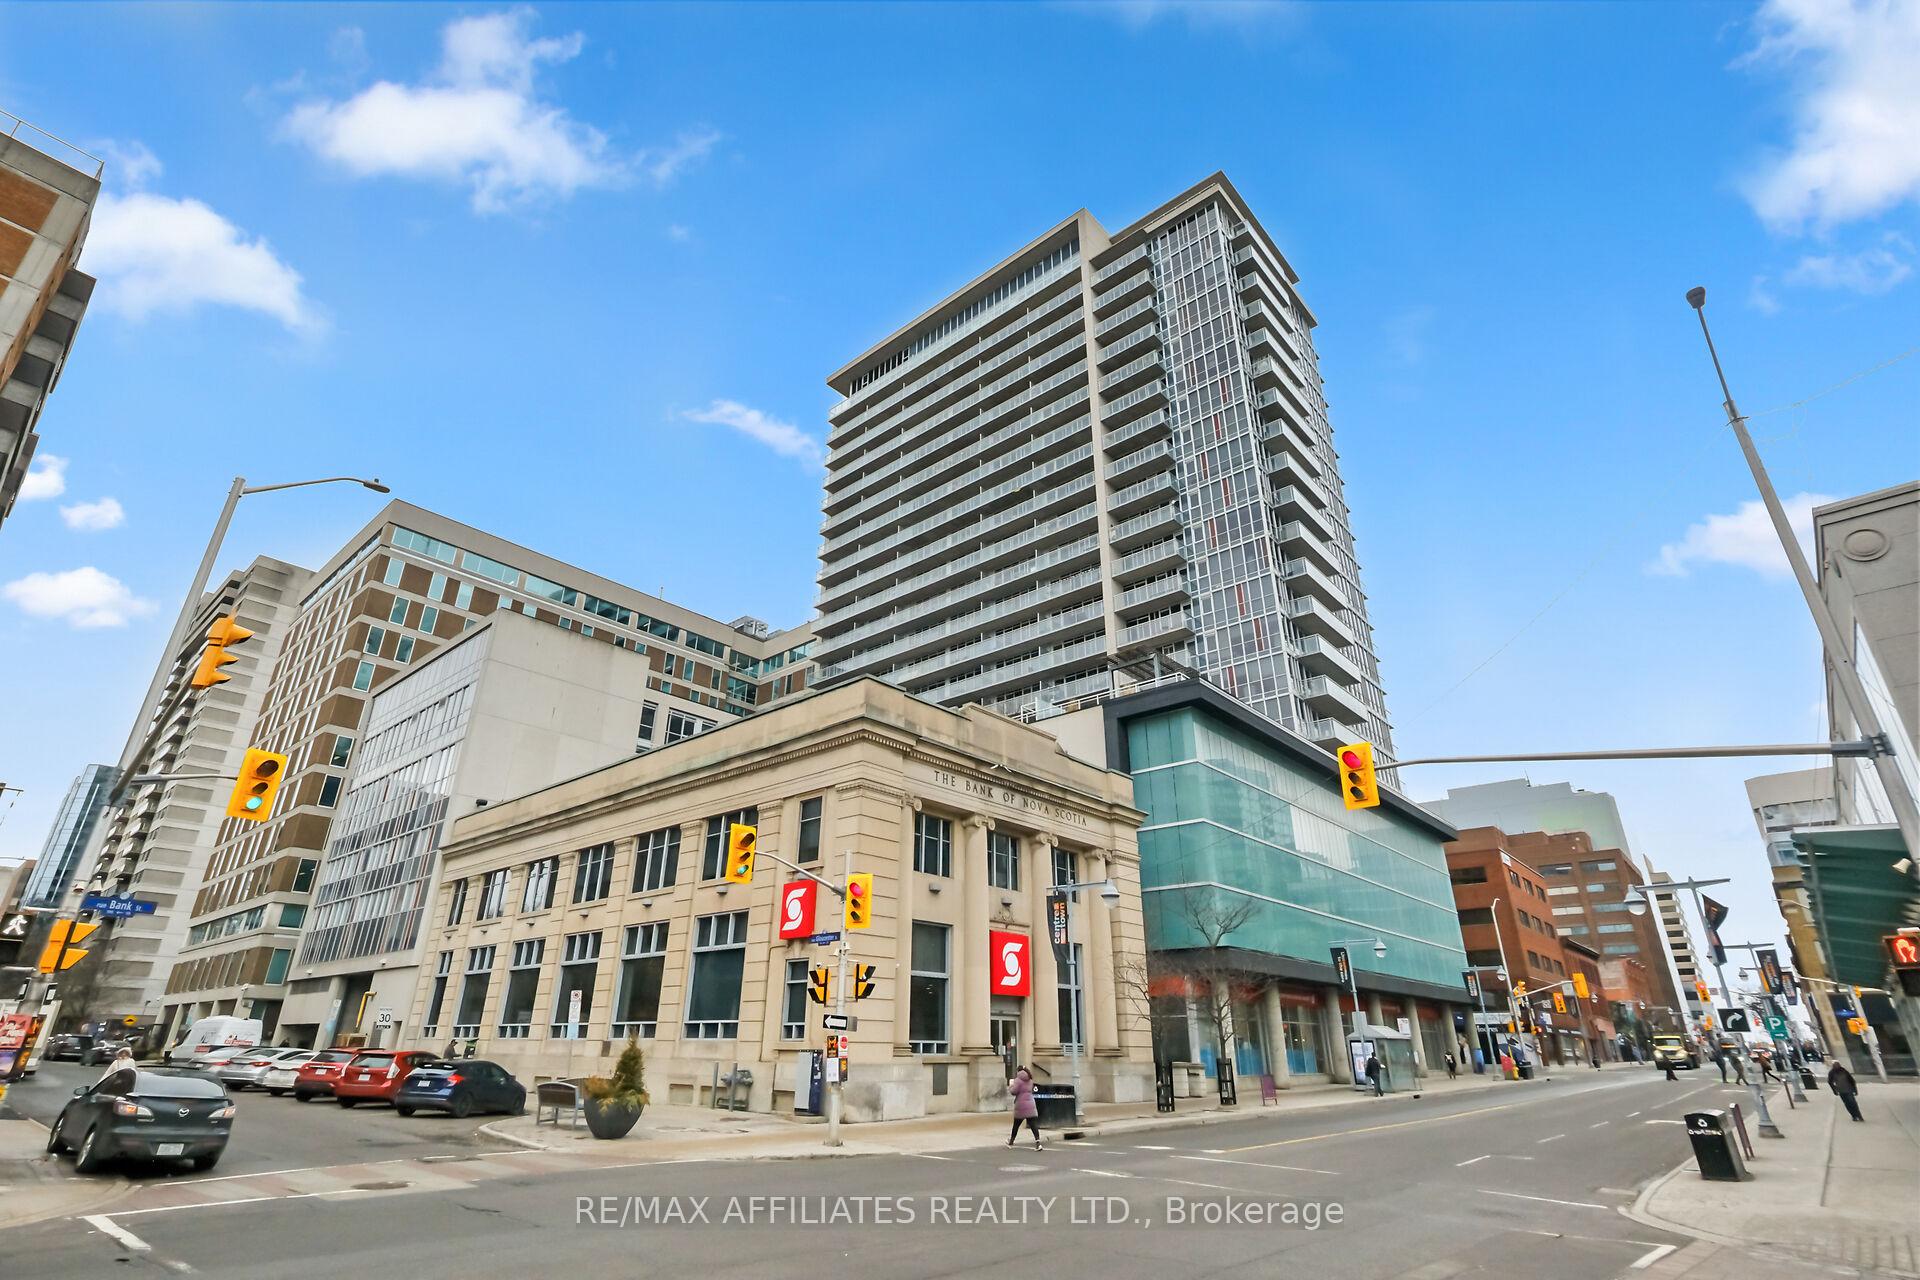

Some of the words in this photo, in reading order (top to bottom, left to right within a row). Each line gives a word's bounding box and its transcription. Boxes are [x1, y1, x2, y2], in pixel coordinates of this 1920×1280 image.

[934, 770, 956, 787] THE
[965, 780, 994, 799] BANK
[1003, 792, 1016, 804] OF
[1023, 798, 1049, 815] NOVA
[1055, 808, 1087, 827] SCOTIA
[109, 900, 132, 910] Bank
[379, 1013, 391, 1023] 30
[1768, 1017, 1782, 1030] P
